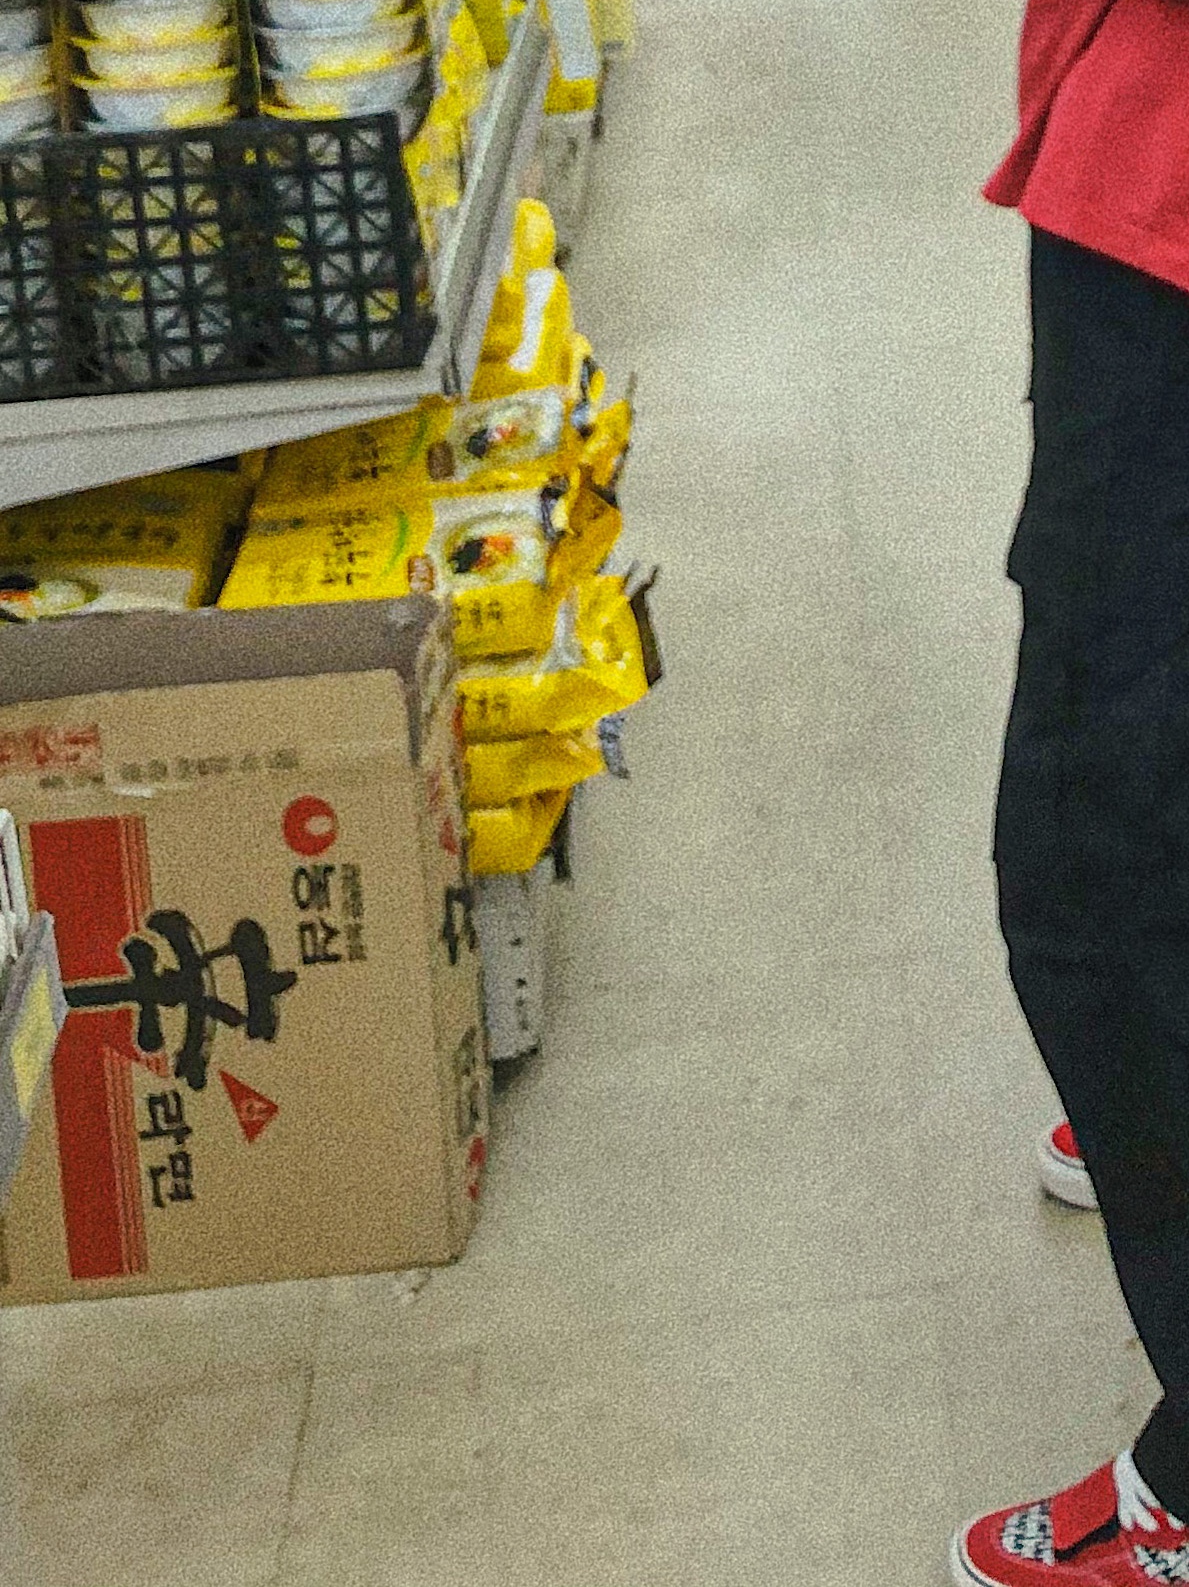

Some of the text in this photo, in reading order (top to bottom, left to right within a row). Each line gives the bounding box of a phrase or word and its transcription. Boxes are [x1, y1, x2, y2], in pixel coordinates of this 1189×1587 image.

[291, 864, 341, 967] 농심
[62, 909, 299, 1090] 辛
[139, 1089, 196, 1209] 라면
